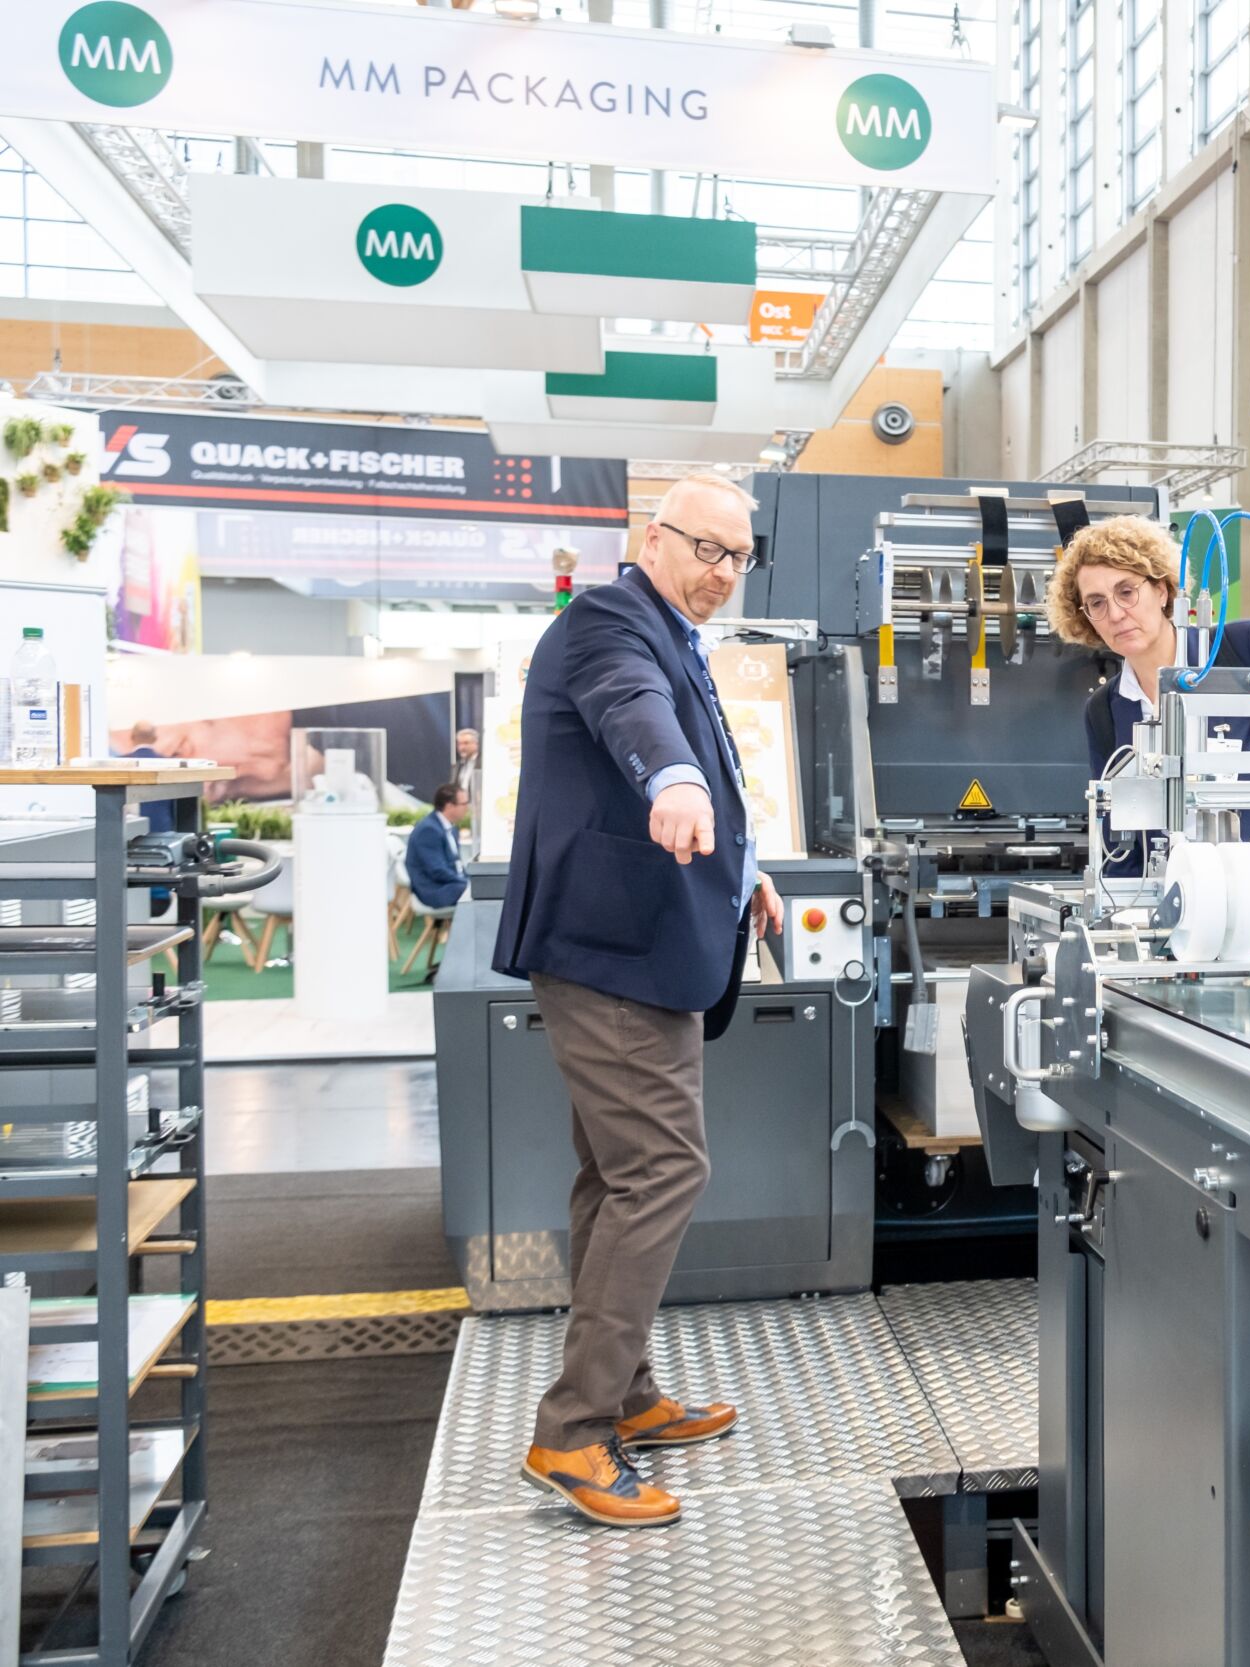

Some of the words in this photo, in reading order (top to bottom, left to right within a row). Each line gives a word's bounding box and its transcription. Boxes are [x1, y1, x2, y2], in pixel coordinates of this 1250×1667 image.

[71, 32, 162, 75] MM
[319, 56, 401, 95] MM
[423, 65, 708, 121] PACKAGING
[846, 103, 922, 141] MM
[365, 228, 435, 261] MM
[190, 440, 465, 479] QUACK+FISCHER
